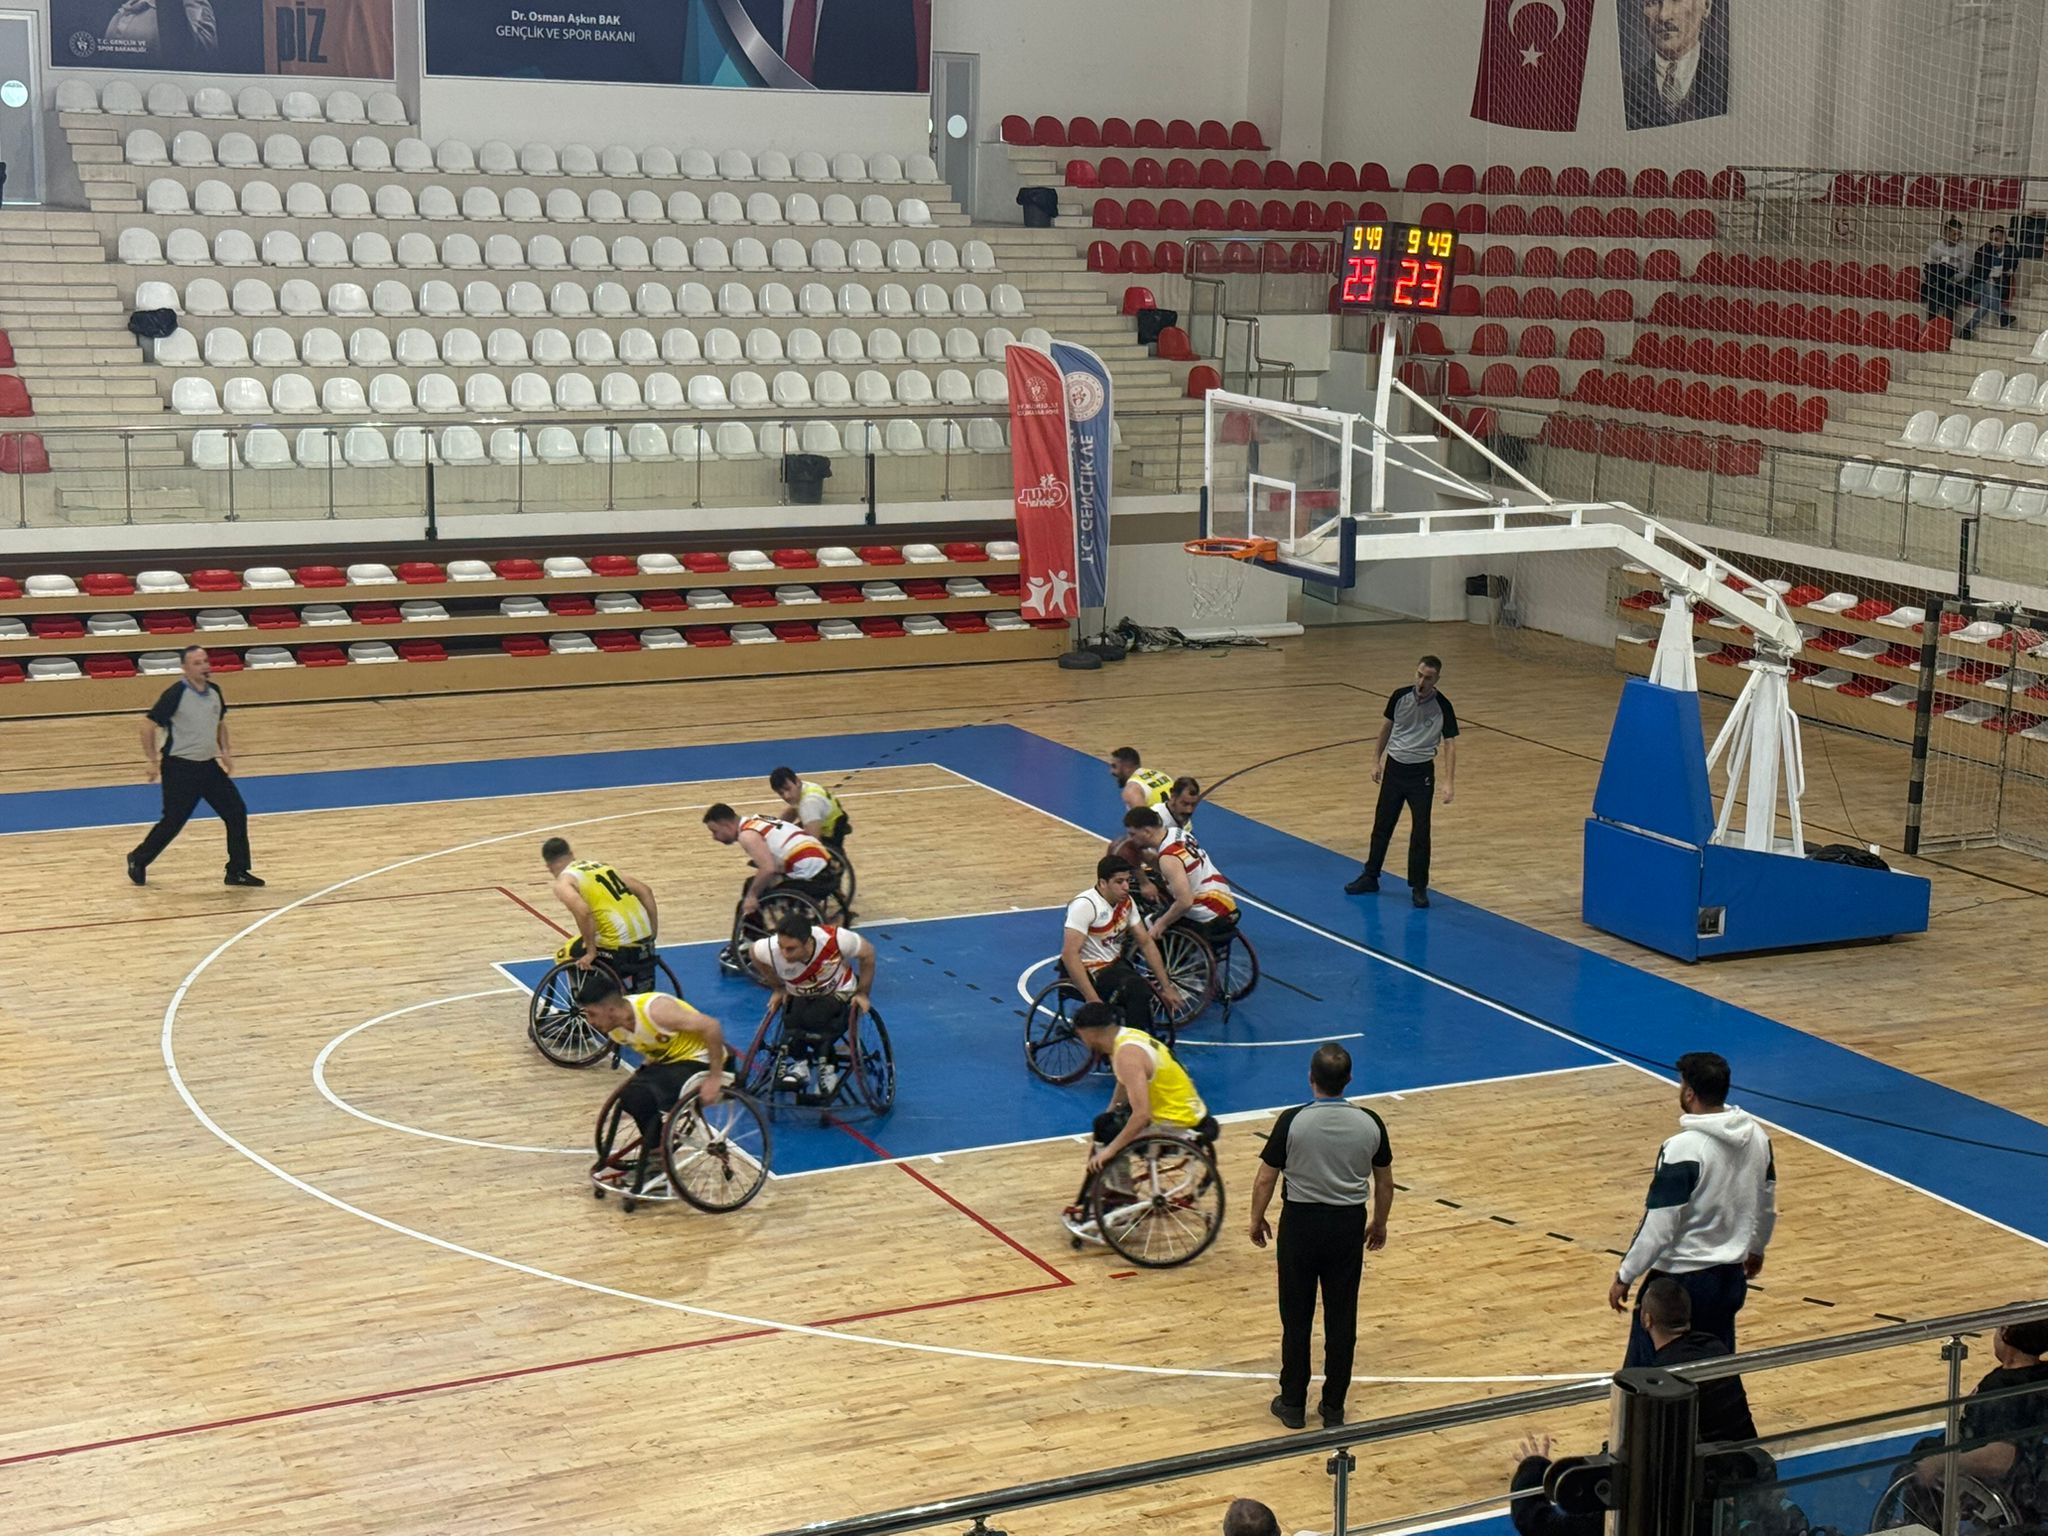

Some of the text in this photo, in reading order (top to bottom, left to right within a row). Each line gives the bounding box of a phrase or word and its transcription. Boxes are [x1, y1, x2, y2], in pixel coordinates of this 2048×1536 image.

[511, 10, 621, 26] Dr. Osman Aşkın BAK
[496, 25, 636, 43] GENÇLİK VE SPOR BAKANI
[1342, 257, 1378, 301] 23
[1394, 260, 1444, 308] 23
[595, 870, 632, 901] 14
